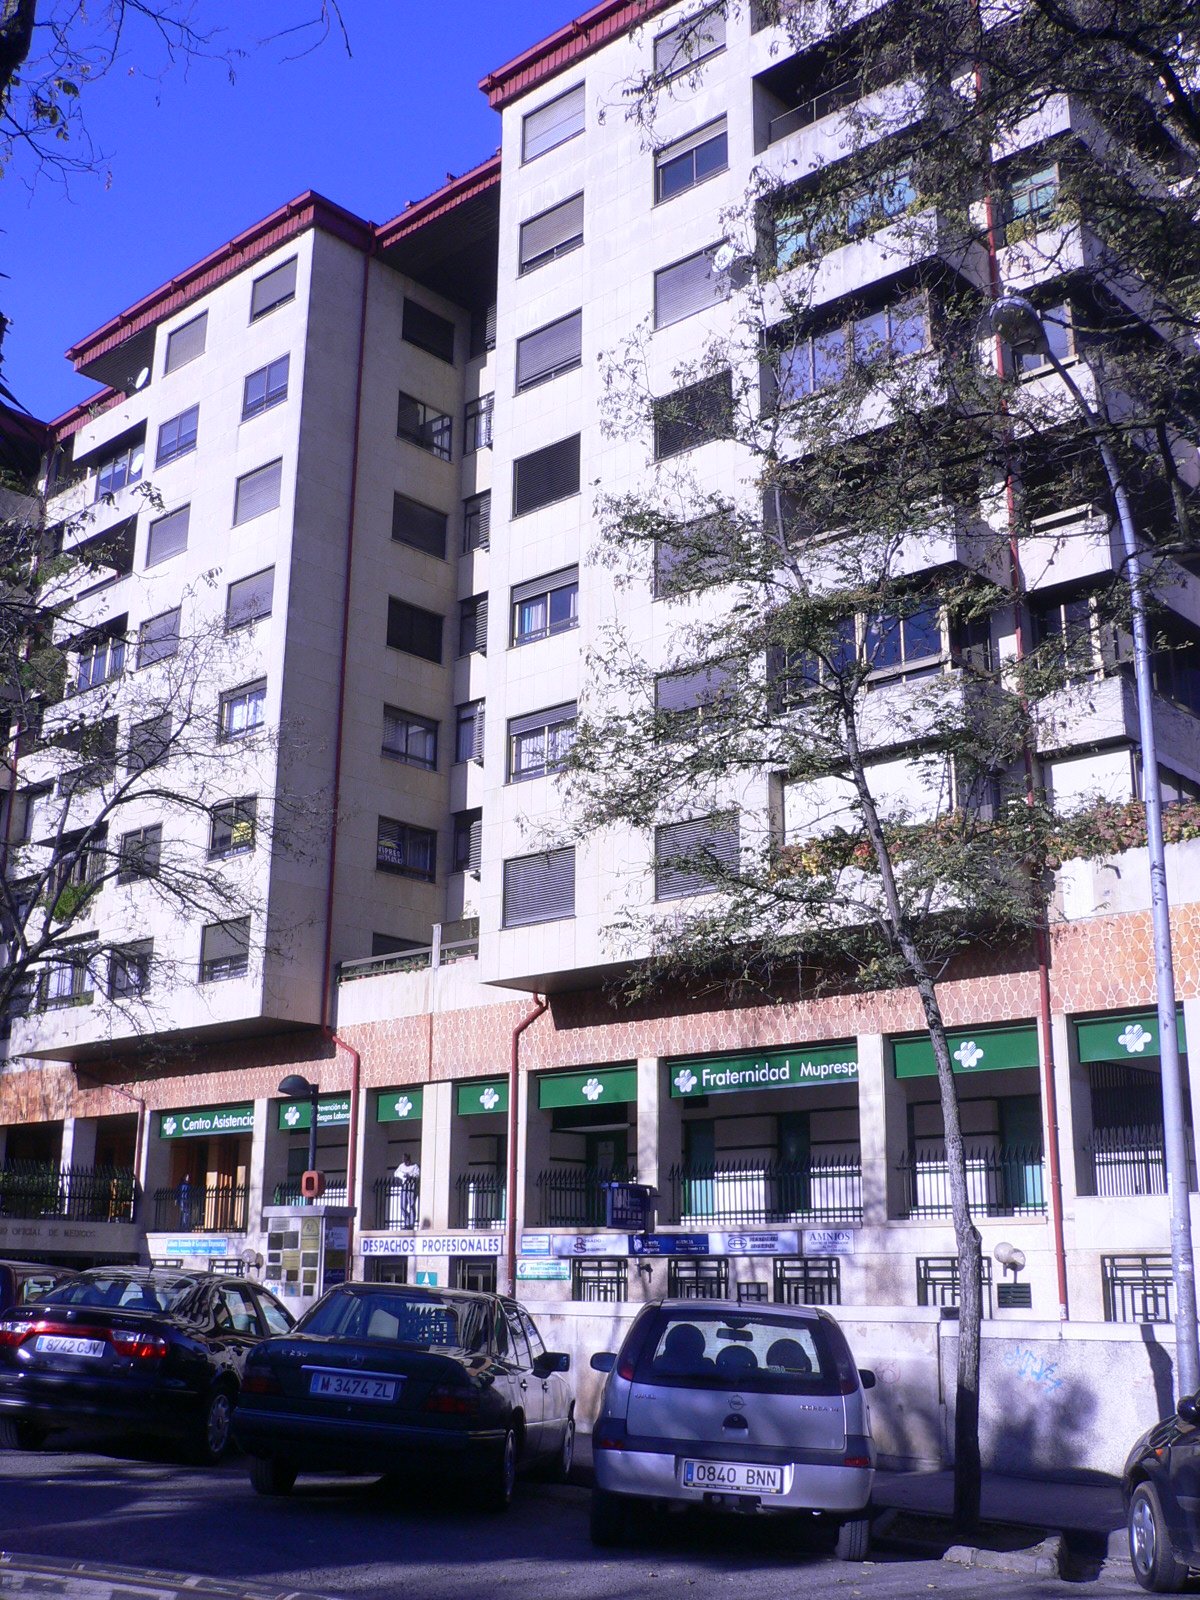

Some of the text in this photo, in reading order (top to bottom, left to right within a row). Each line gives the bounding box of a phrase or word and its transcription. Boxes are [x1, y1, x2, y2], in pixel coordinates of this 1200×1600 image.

[702, 1060, 790, 1087] Fraternidad
[341, 1101, 349, 1110] de
[182, 1116, 211, 1131] Centro
[49, 1228, 58, 1237] DE
[809, 1232, 851, 1241] AMNIOS
[362, 1238, 499, 1253] DESPACHOS PROFESIONALES
[45, 1339, 74, 1353] 8742
[334, 1378, 369, 1396] 3474
[373, 1382, 391, 1398] ZL
[696, 1465, 777, 1487] 0840 BNN
